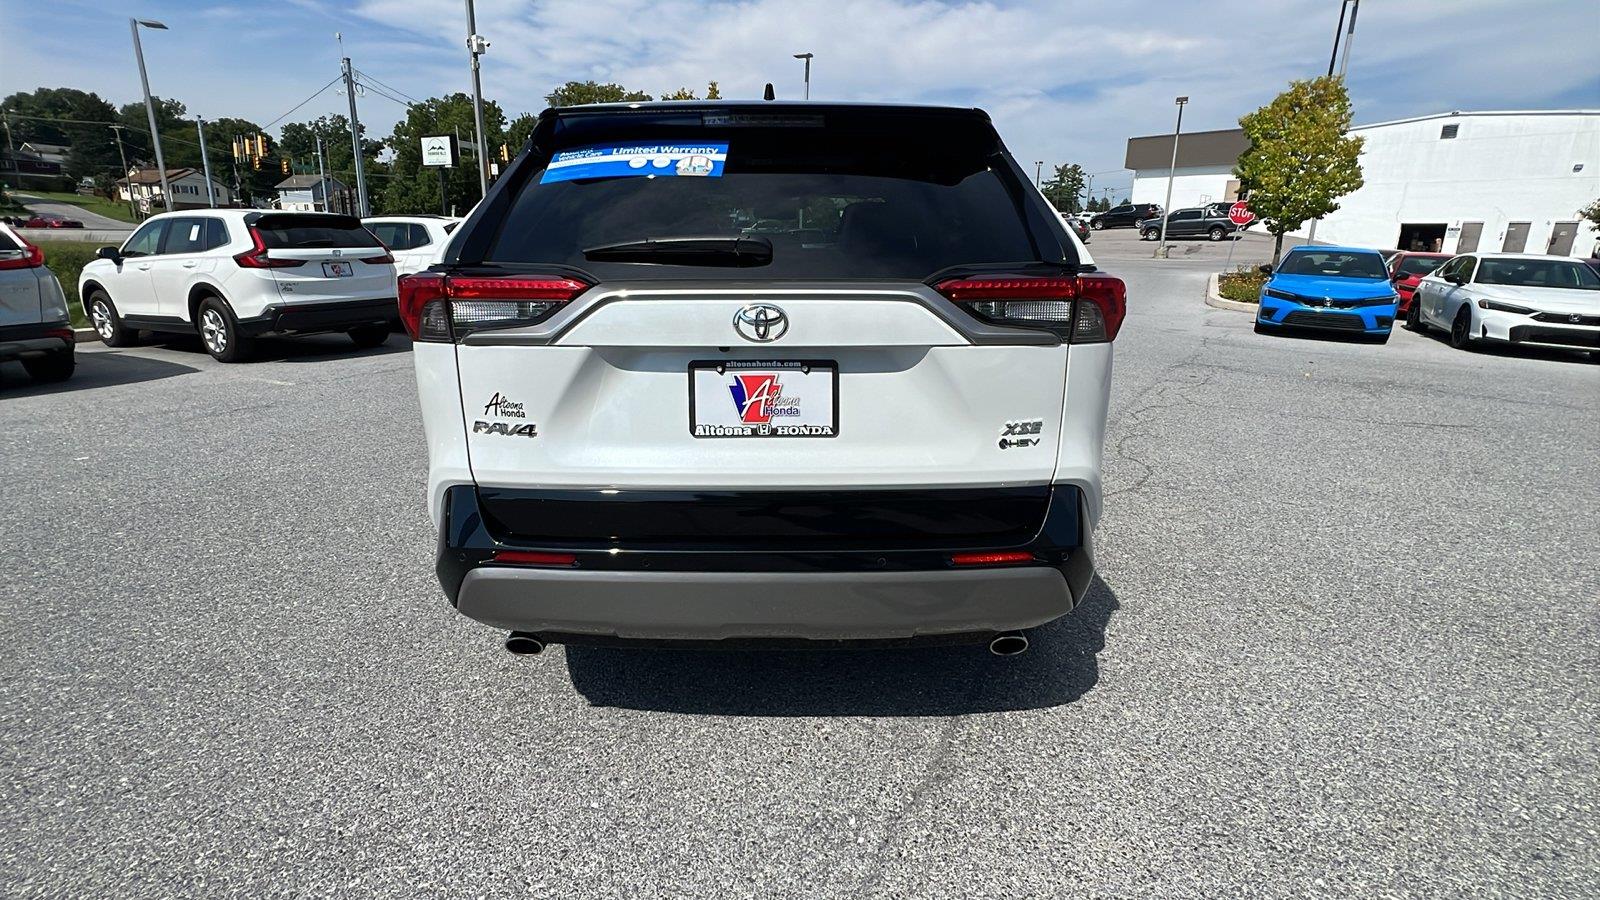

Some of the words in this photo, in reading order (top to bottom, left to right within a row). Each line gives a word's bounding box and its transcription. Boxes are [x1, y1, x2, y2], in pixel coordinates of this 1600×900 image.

[612, 146, 658, 155] Limited
[660, 145, 719, 155] Warranty
[725, 360, 802, 368] altoonahonda.com
[742, 378, 801, 418] Altoona
[484, 392, 524, 417] Altoona
[500, 409, 526, 418] Honda
[765, 406, 801, 416] Honda
[472, 420, 538, 438] RAV4
[694, 425, 753, 436] Altoona
[776, 426, 833, 436] HONDA
[1001, 421, 1043, 436] XSE
